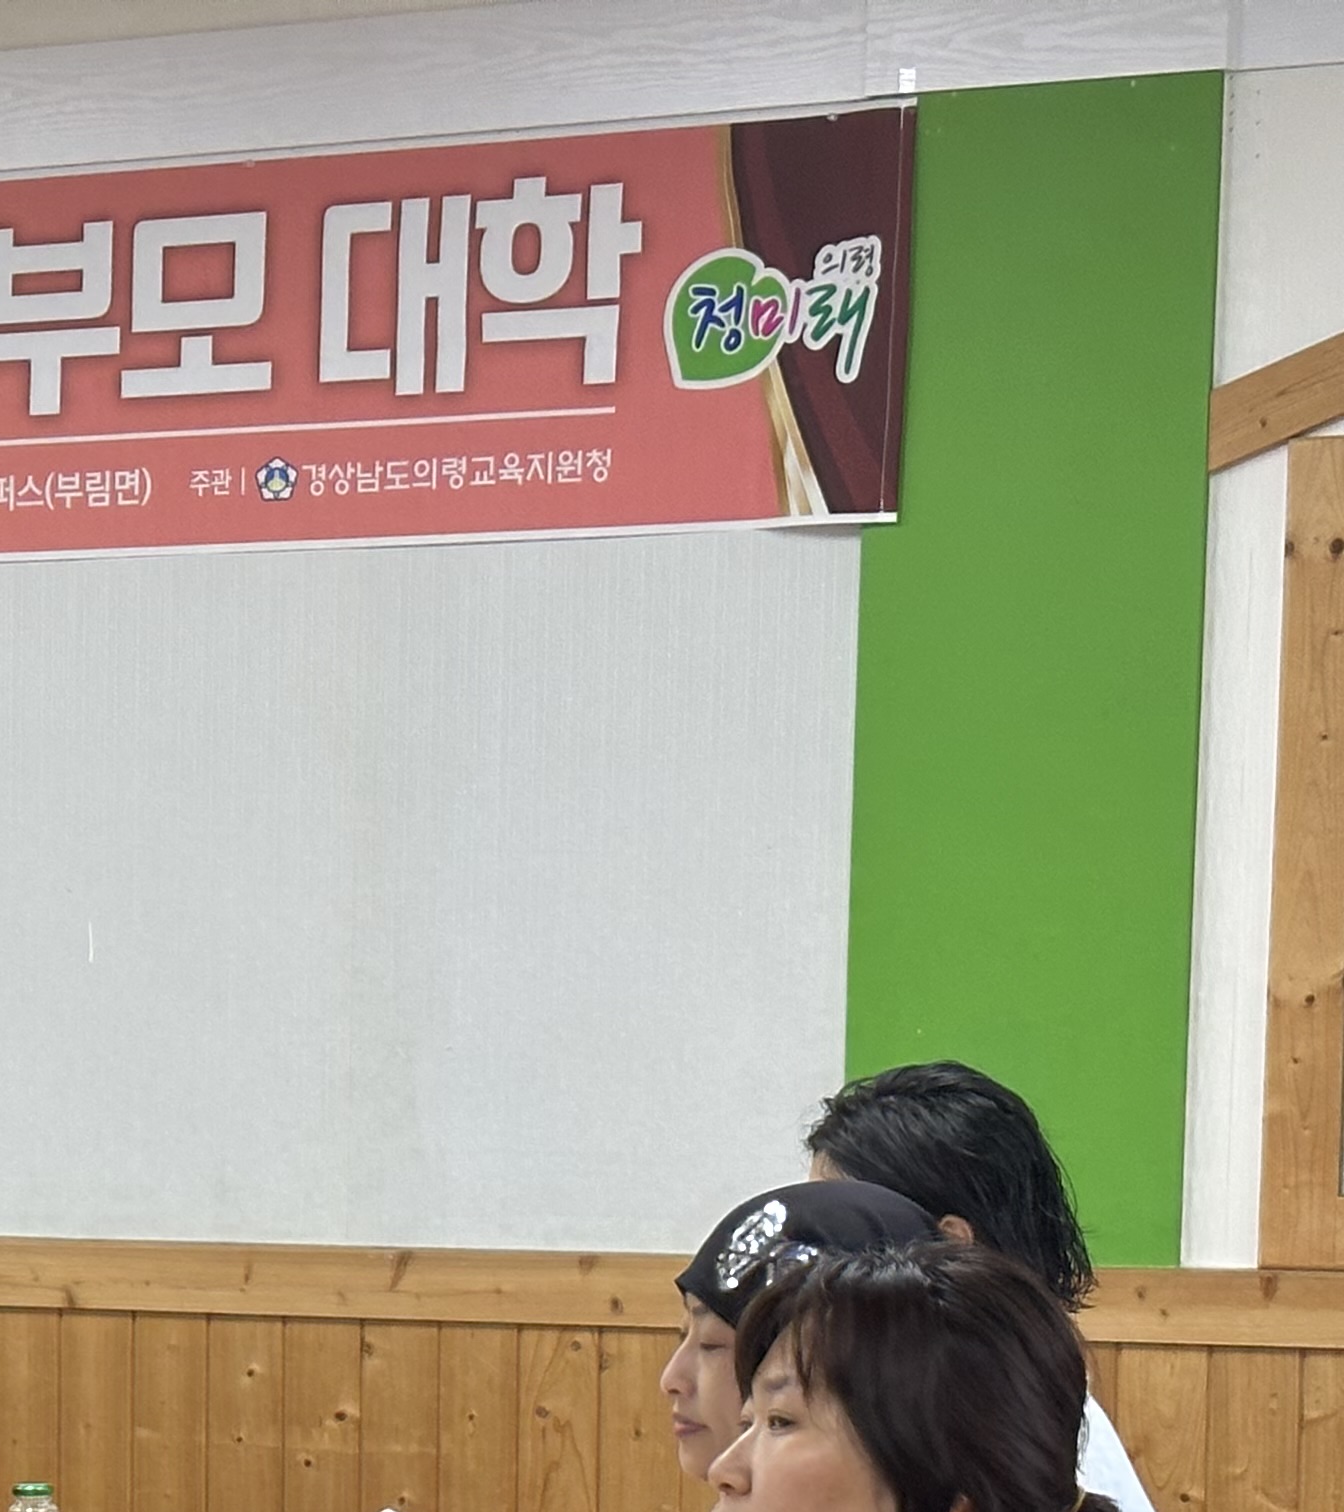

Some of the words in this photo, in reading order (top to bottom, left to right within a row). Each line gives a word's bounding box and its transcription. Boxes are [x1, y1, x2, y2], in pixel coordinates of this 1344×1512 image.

[319, 176, 642, 396] 대학
[821, 245, 874, 276] 의령
[690, 284, 870, 375] 청미래
[189, 468, 232, 497] 주관
[302, 448, 612, 497] 경상남도의령교육지원청
